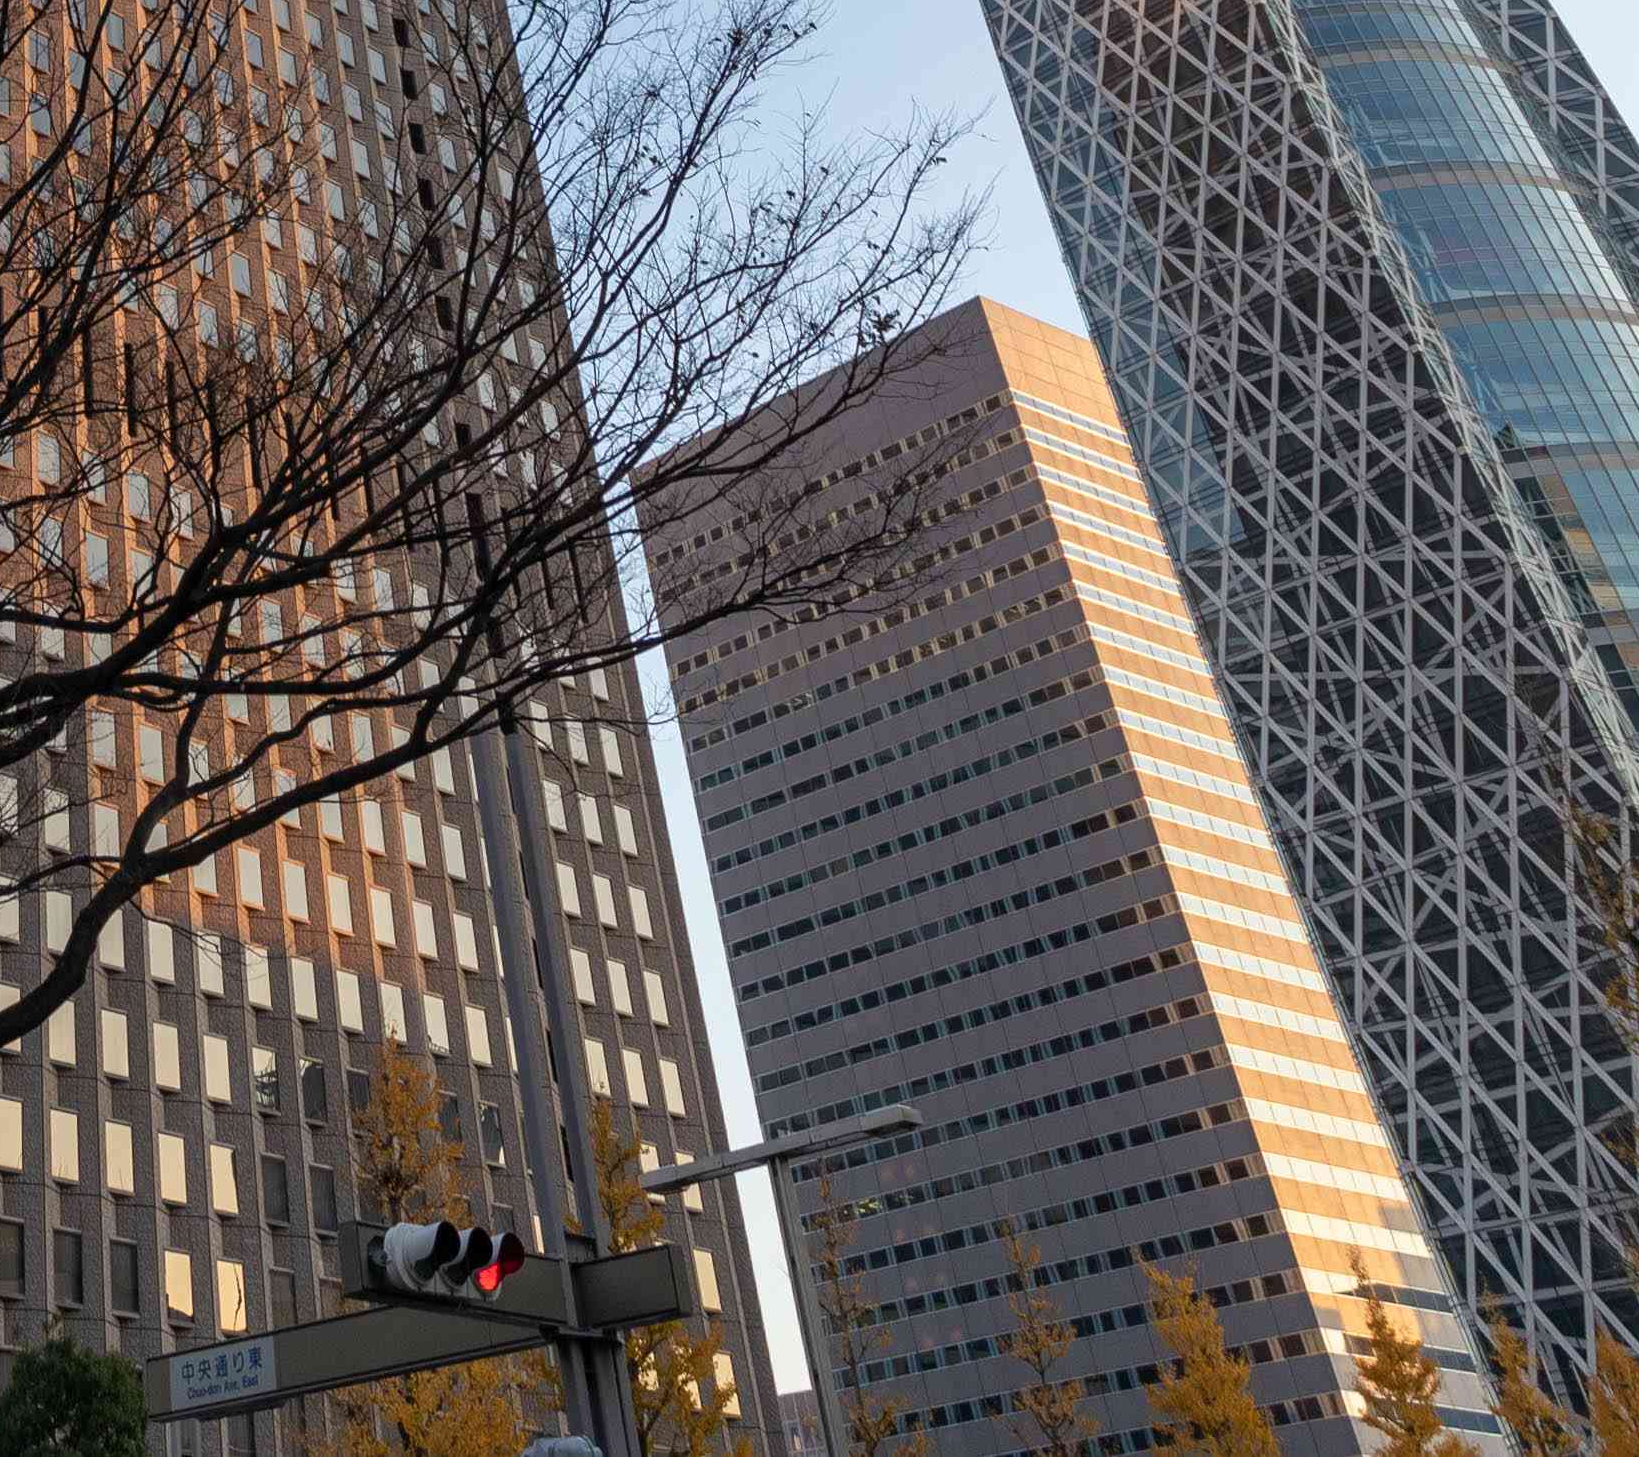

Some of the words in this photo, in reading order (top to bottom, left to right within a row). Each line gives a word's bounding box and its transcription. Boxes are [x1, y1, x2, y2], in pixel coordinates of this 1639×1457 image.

[182, 1347, 262, 1383] 中央通り東
[242, 1374, 259, 1388] East
